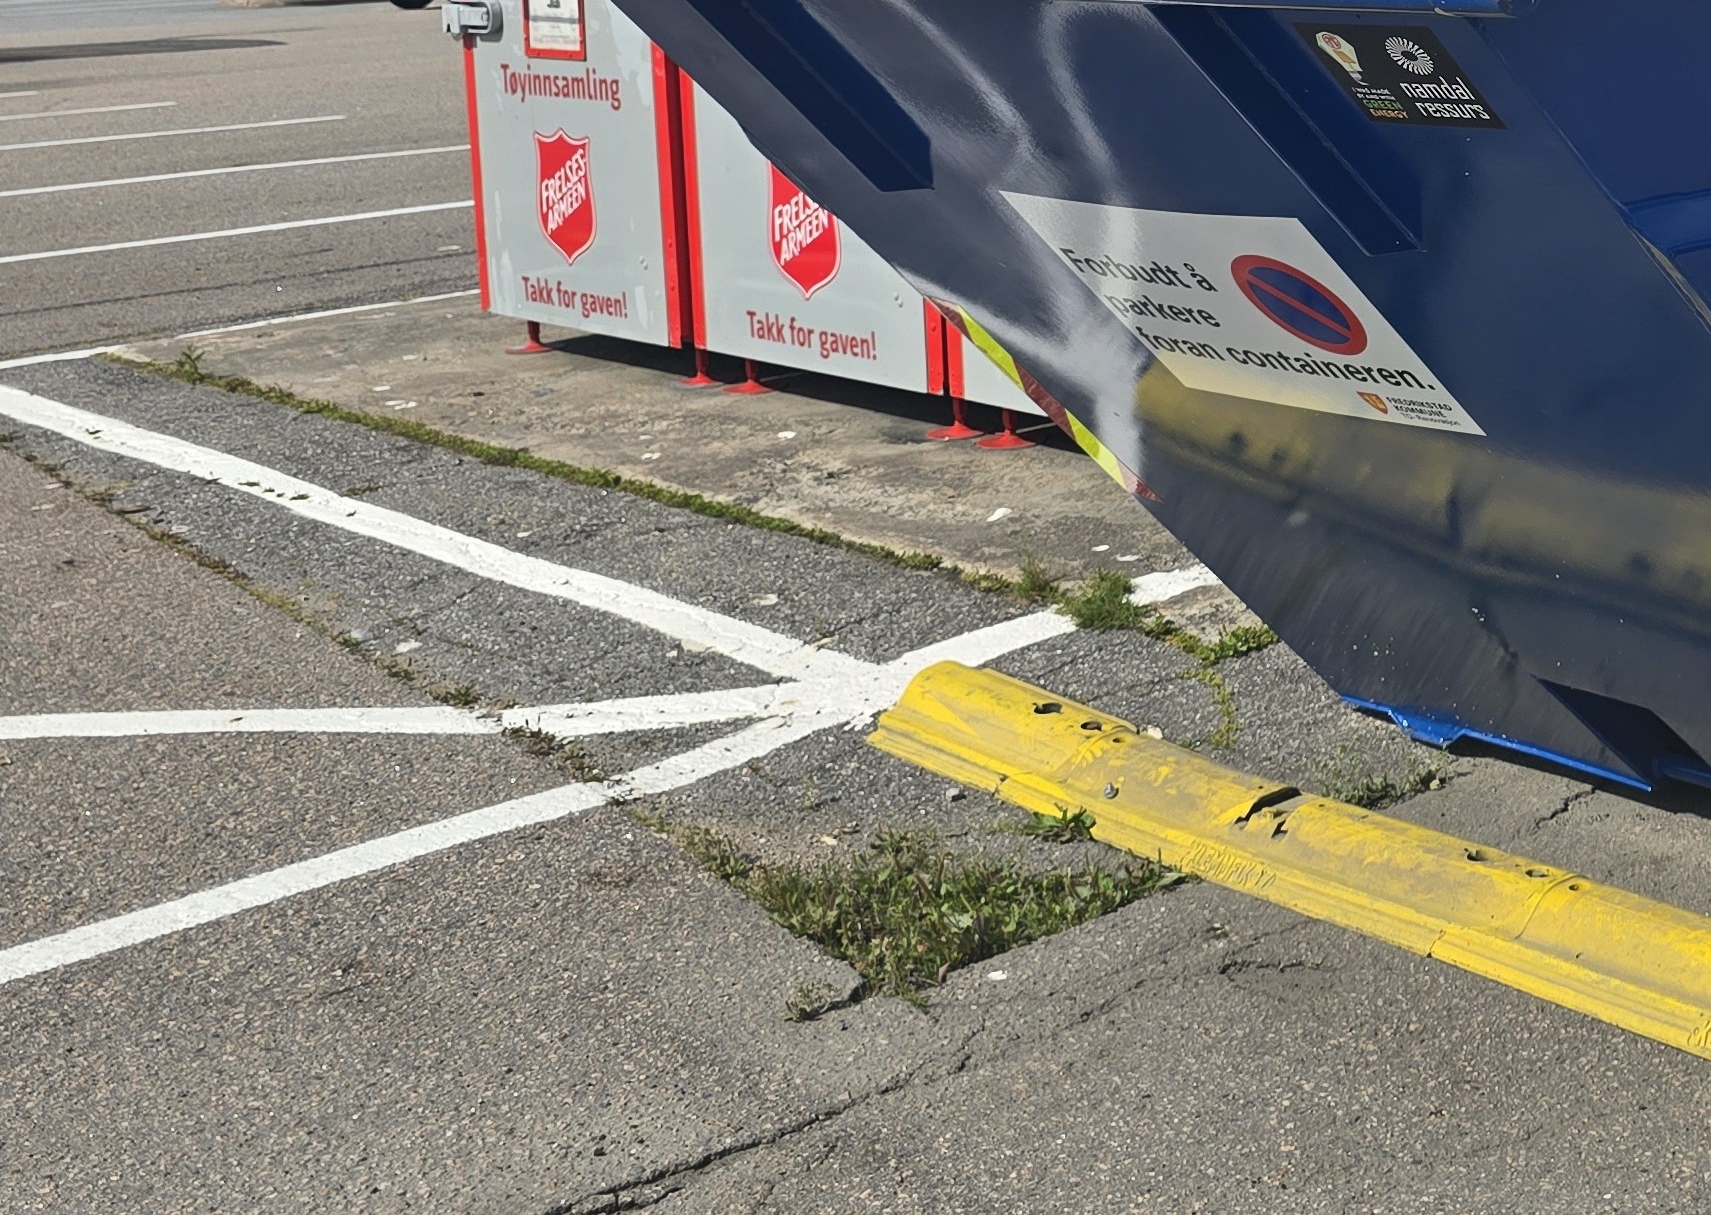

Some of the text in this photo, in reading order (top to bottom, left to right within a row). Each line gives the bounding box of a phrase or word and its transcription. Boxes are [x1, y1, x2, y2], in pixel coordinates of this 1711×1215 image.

[500, 63, 621, 111] Tøyinnsamling
[1363, 99, 1403, 110] GREEN
[1399, 75, 1476, 101] namdal
[1369, 108, 1409, 119] ENERGY
[1414, 102, 1491, 120] ressurs
[547, 176, 587, 236] ARMEEN
[780, 206, 829, 267] ARMEEN
[1059, 247, 1219, 293] Forbudt å
[521, 275, 628, 320] Takk for gaven!
[1104, 293, 1221, 329] parkere
[746, 310, 878, 361] Takk for gaven!
[1136, 325, 1437, 390] foran containeren.
[1386, 396, 1453, 412] FREDRIKSTAD
[1393, 404, 1447, 419] KOMMUNE
